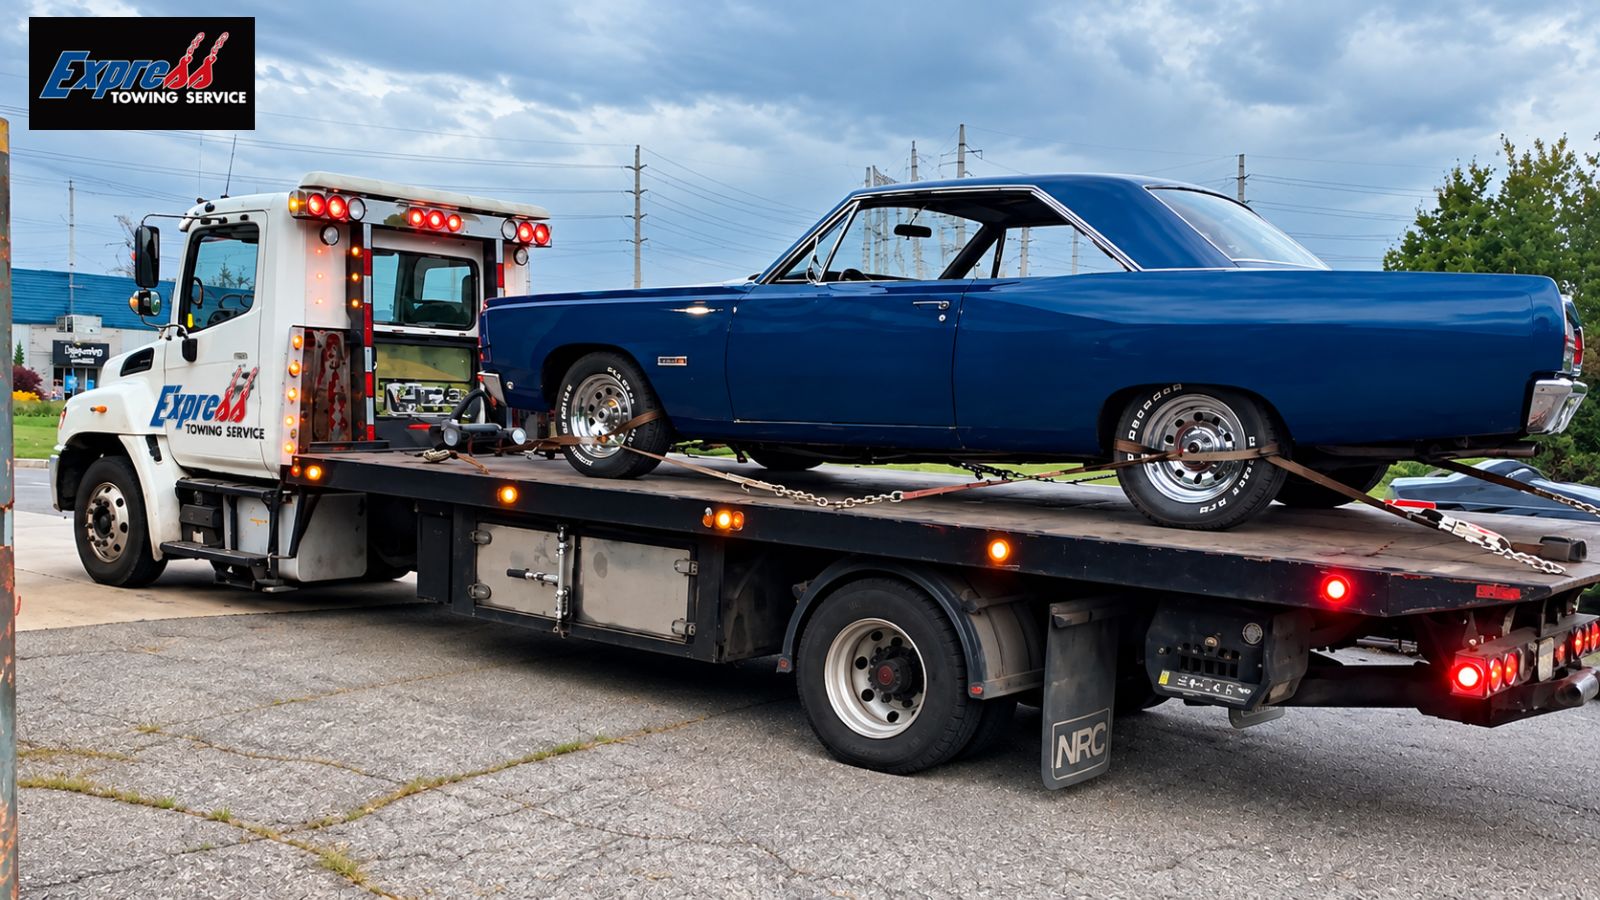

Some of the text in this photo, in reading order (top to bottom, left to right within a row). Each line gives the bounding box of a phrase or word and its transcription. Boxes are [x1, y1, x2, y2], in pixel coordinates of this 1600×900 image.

[150, 368, 260, 429] Express
[186, 424, 265, 440] TOWING SERVICE
[1055, 721, 1107, 769] NRC
